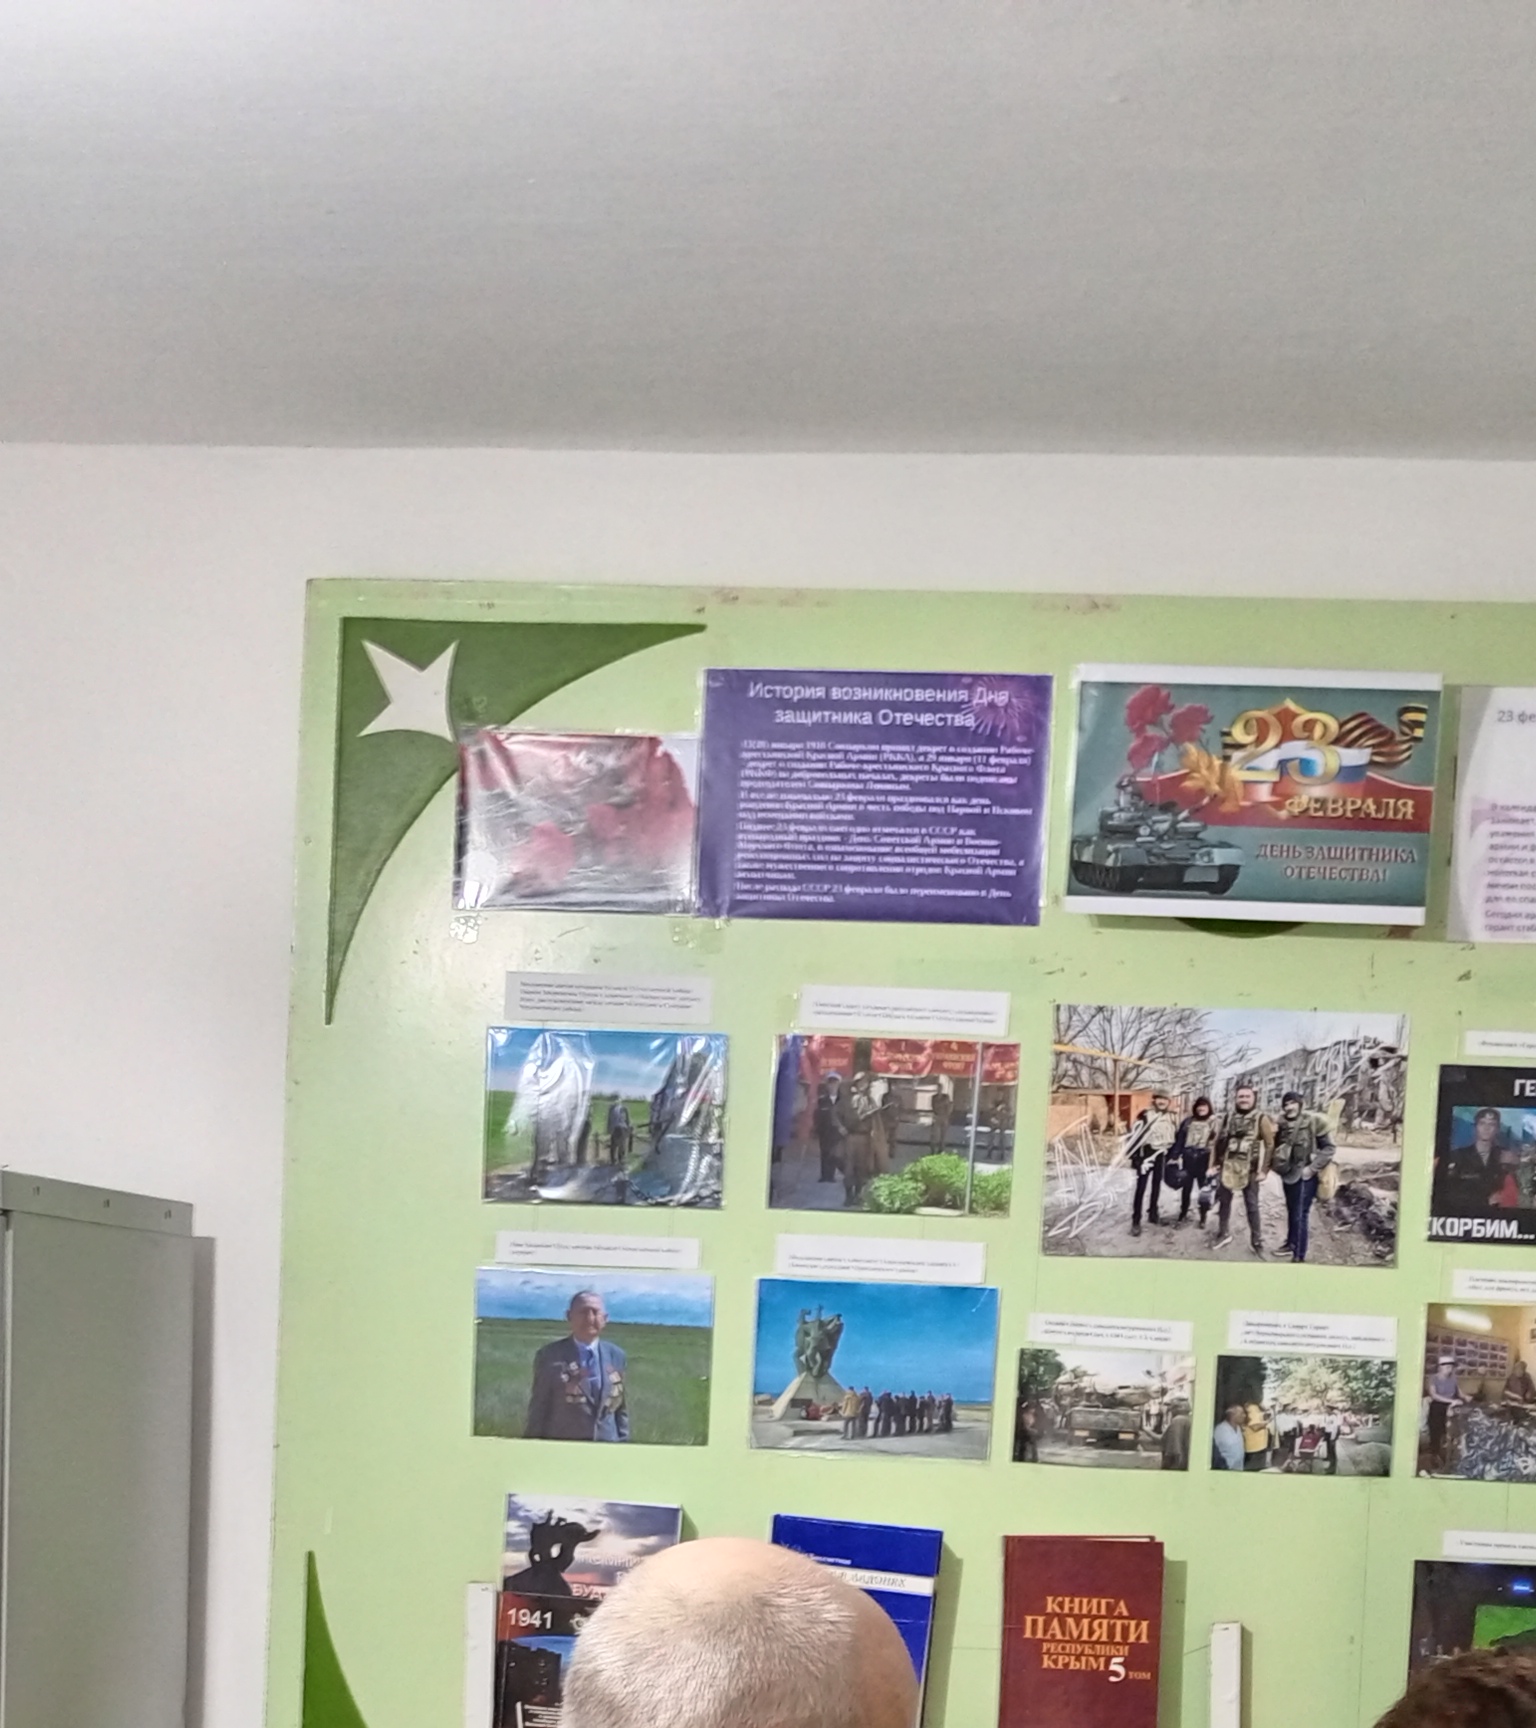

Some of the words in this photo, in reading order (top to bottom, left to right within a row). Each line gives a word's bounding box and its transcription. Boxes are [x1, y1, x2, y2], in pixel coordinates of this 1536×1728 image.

[749, 682, 825, 701] История
[831, 685, 968, 702] возникновения
[972, 688, 1010, 707] Дня
[774, 709, 873, 726] защитника
[878, 709, 975, 727] Отечества
[1497, 710, 1514, 722] 23
[1231, 710, 1341, 785] 23
[1285, 795, 1415, 820] ФЕВРАЛЯ
[1256, 843, 1302, 860] ДЕНЬ
[1307, 845, 1417, 864] ЗАЩИТНИКА
[1283, 865, 1388, 882] ОТЕЧЕСТВА!
[1046, 1596, 1130, 1616] КНИГА
[507, 1608, 553, 1629] 1941
[1023, 1615, 1150, 1644] ПАМЯТИ
[1042, 1642, 1130, 1656] РЕСПУБЛИКИ
[1042, 1655, 1106, 1671] КРЫМ
[1108, 1656, 1126, 1682] 5
